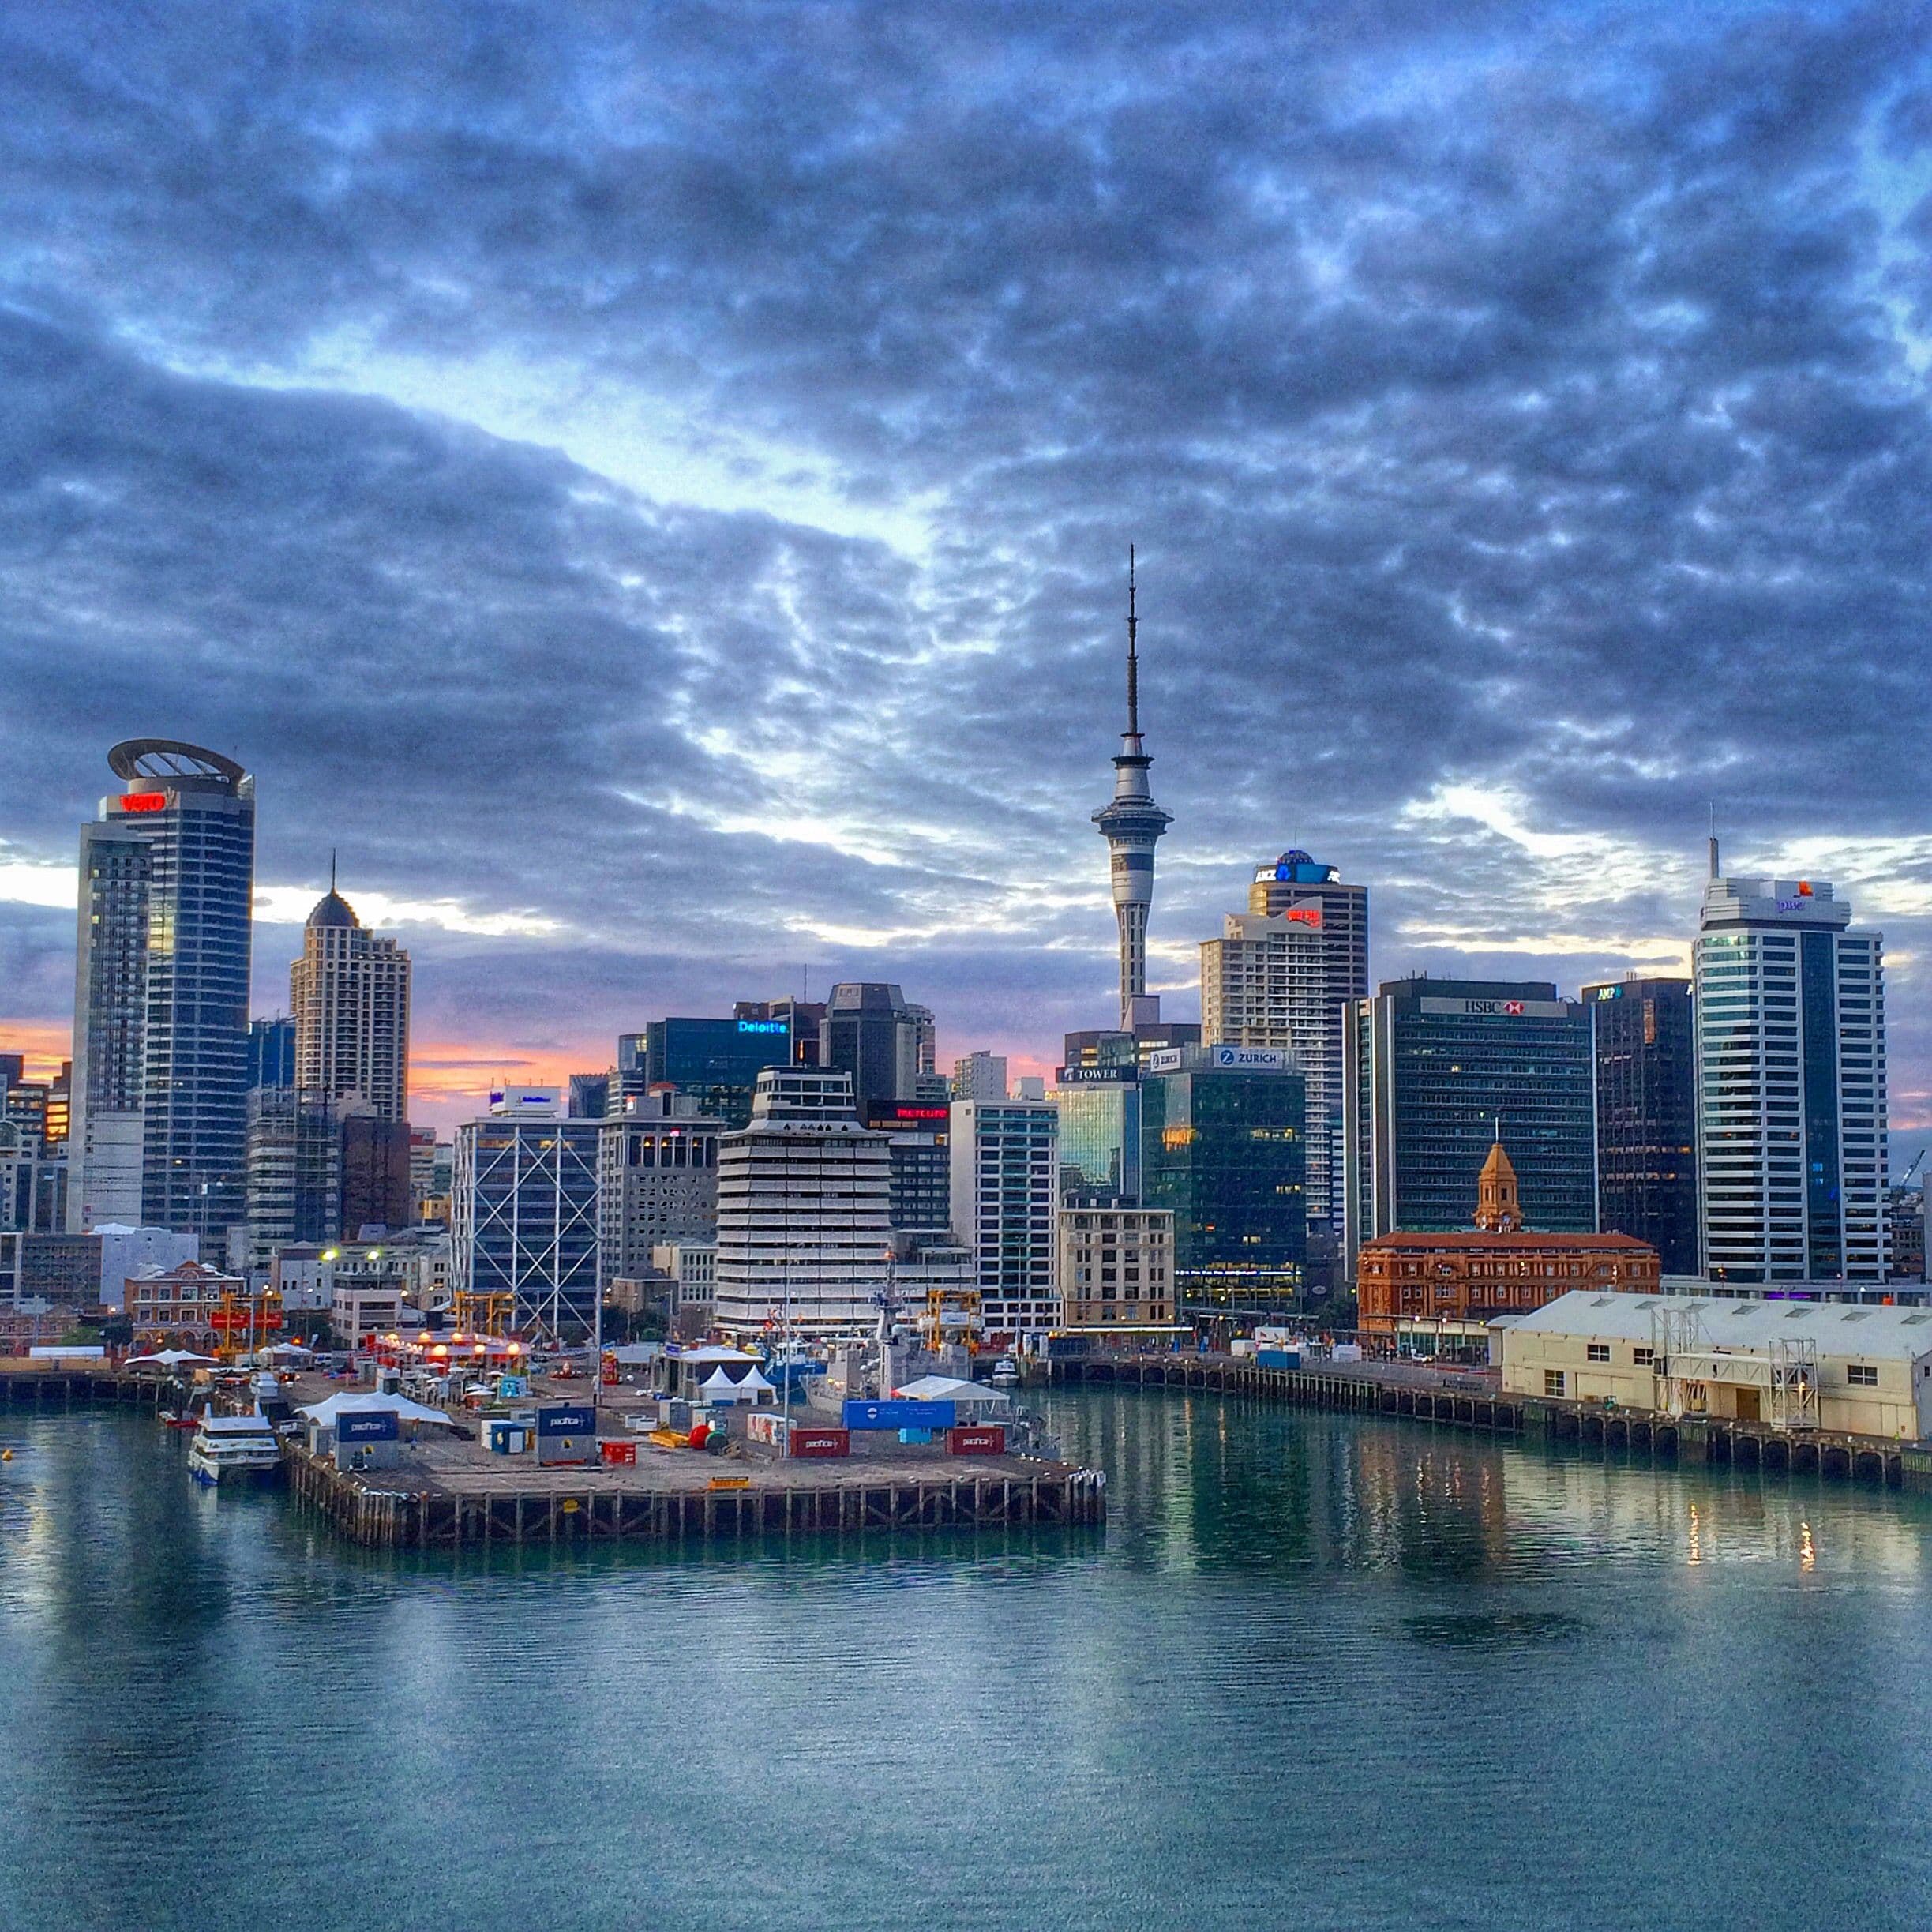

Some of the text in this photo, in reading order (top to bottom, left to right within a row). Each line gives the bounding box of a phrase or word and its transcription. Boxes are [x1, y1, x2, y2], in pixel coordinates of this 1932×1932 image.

[1465, 1000, 1502, 1014] HSBC
[1238, 1053, 1277, 1064] ZURICH
[1078, 1069, 1118, 1079] TOWER
